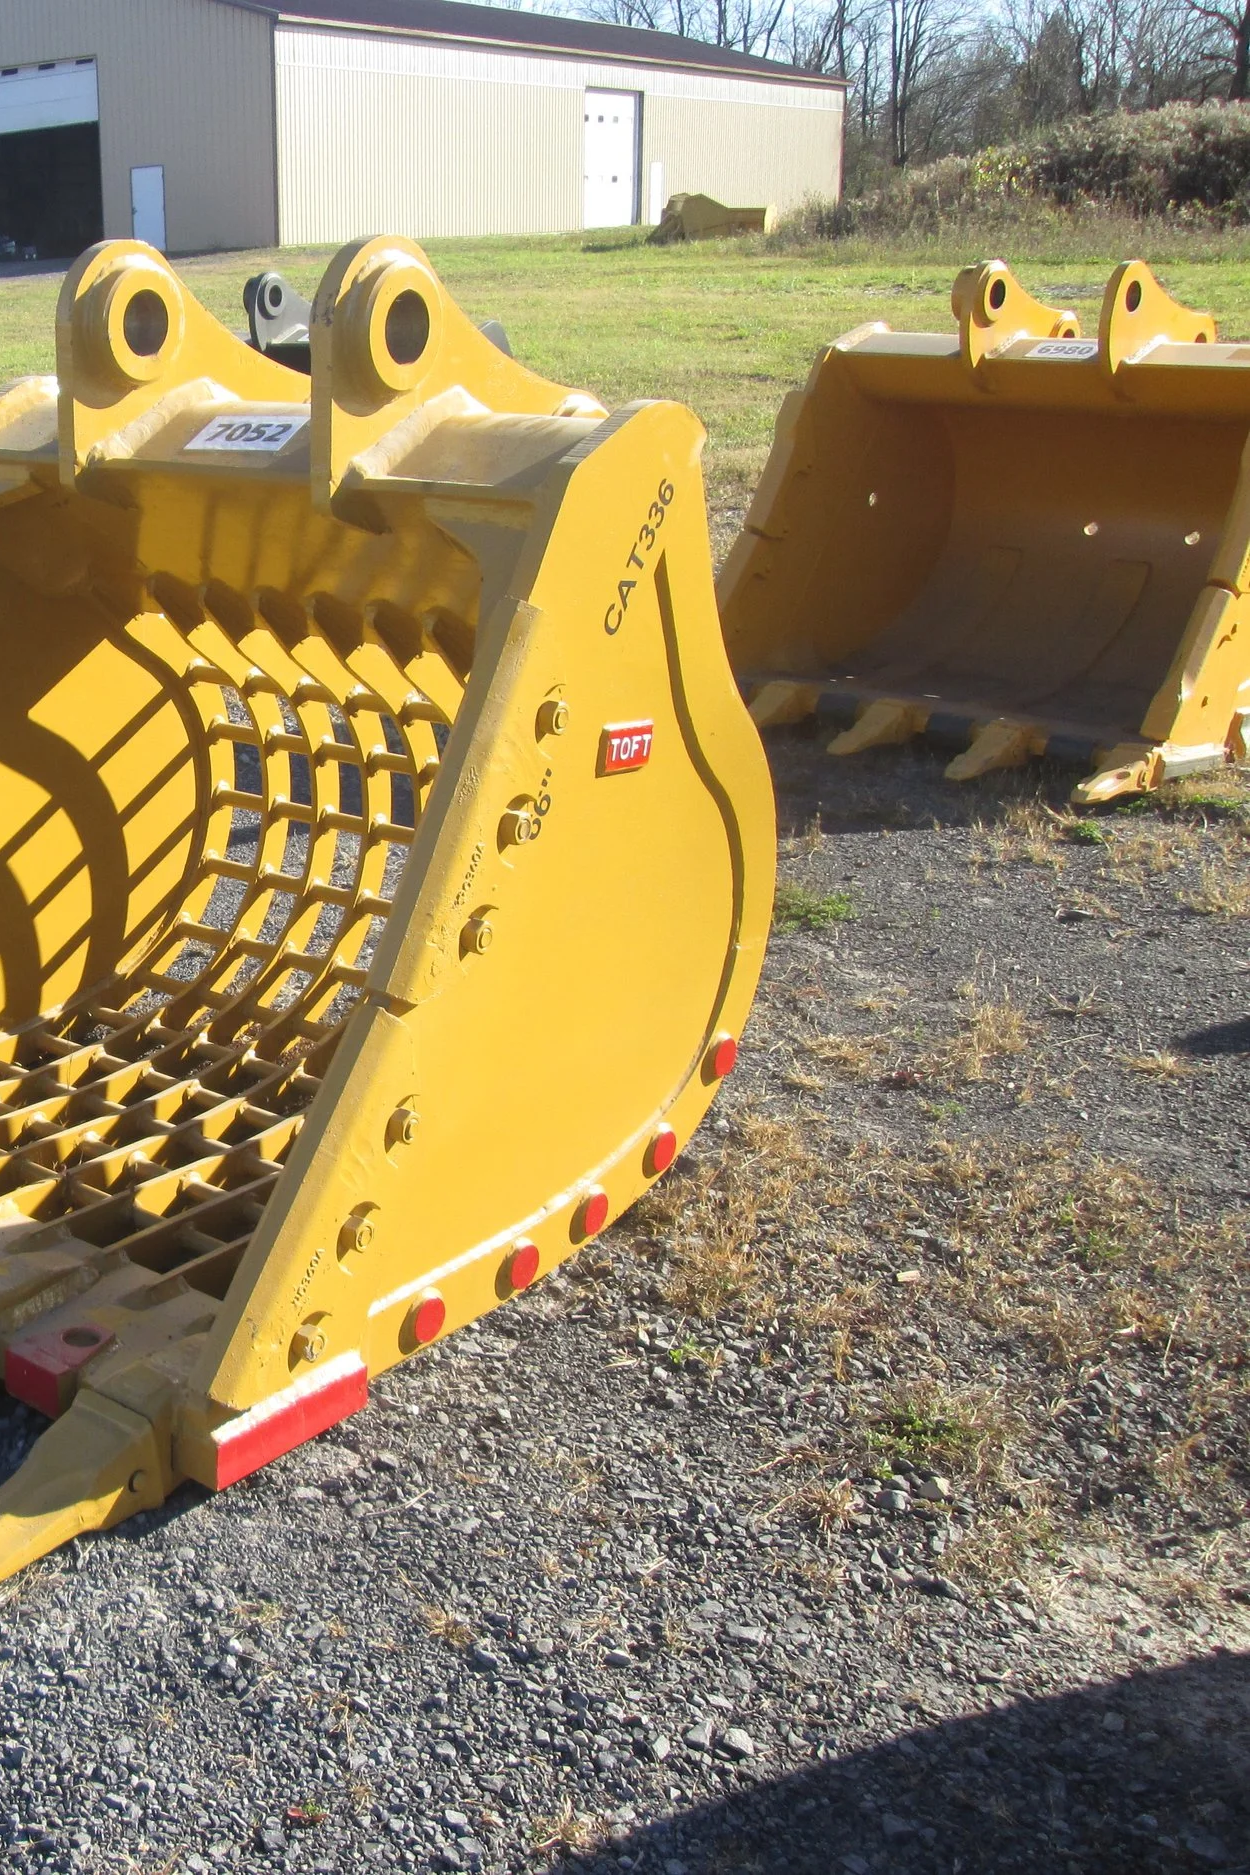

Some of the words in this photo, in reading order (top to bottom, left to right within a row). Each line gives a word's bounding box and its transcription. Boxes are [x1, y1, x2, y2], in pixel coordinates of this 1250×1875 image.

[1037, 345, 1094, 355] 6980
[205, 423, 293, 442] 7052
[603, 478, 675, 637] CAT336
[610, 732, 652, 762] TOFT
